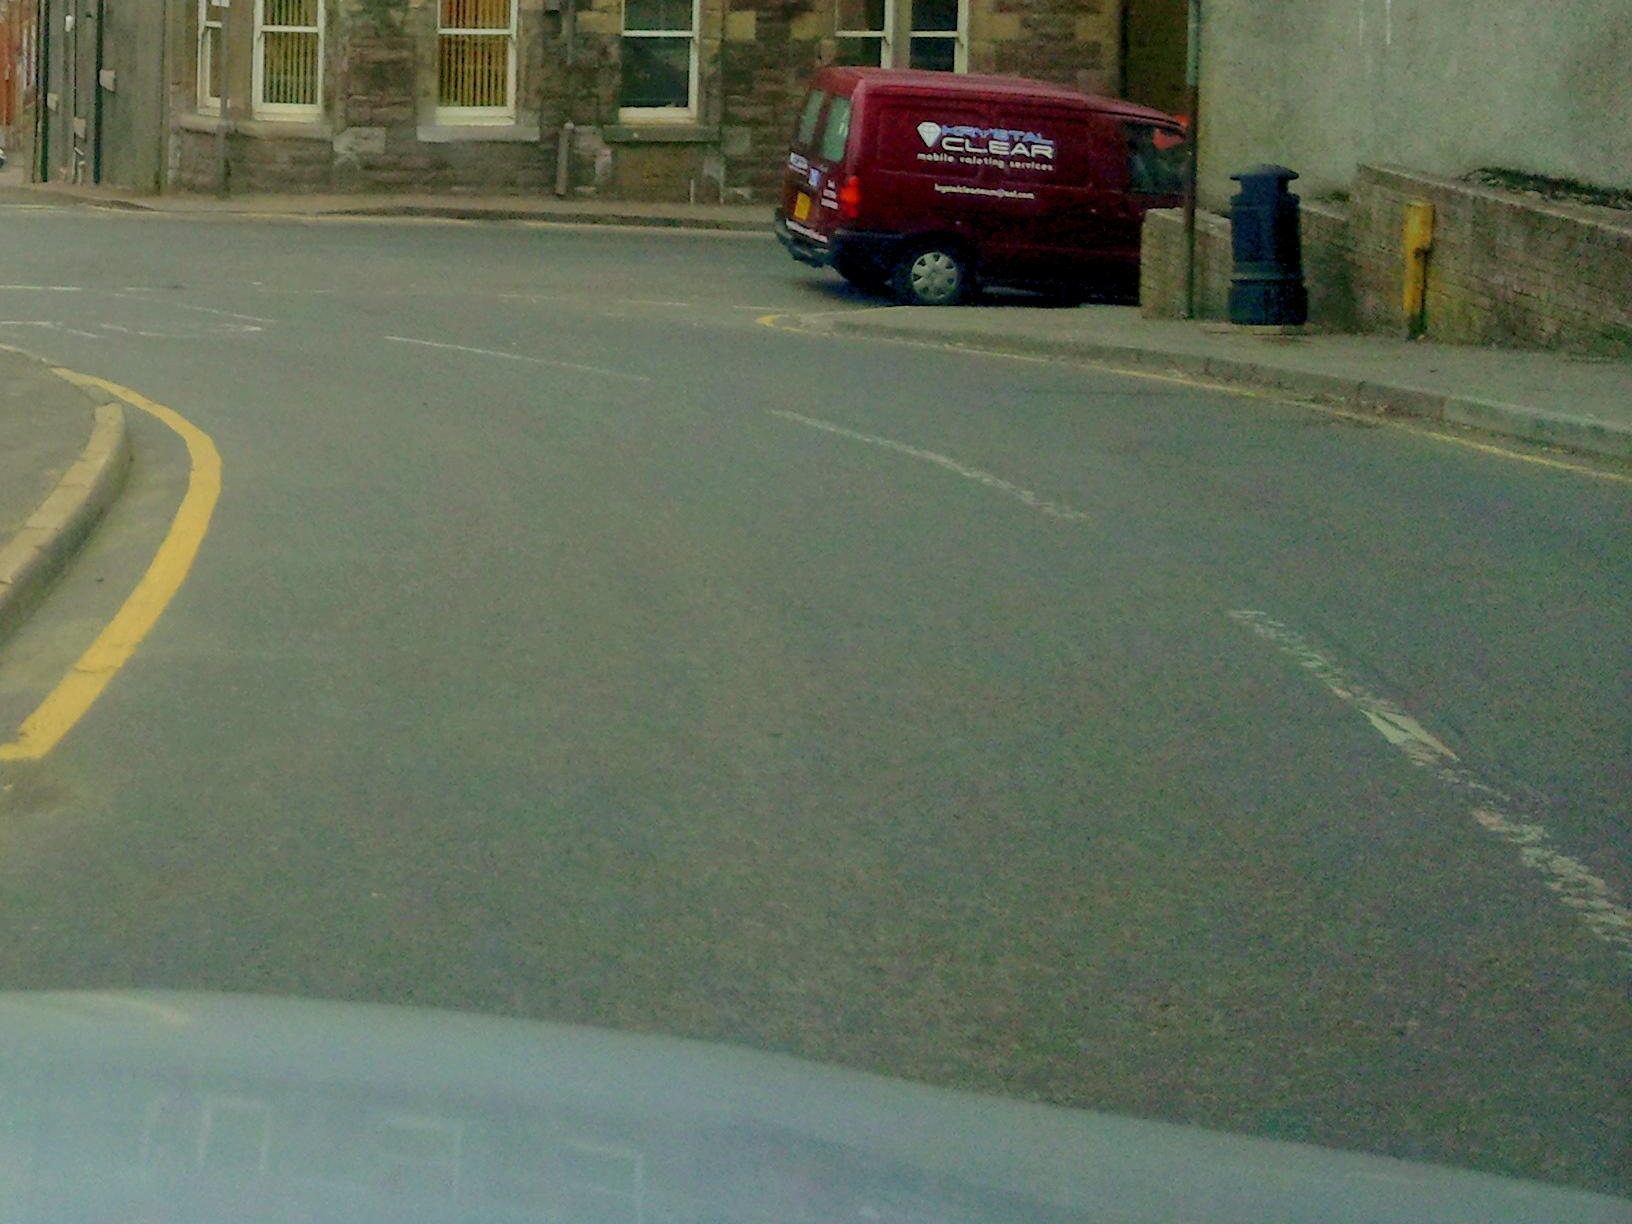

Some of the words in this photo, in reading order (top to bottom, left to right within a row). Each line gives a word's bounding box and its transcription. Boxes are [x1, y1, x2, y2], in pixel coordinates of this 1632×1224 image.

[941, 136, 1054, 159] CLEAR
[917, 153, 954, 163] mobile
[959, 156, 1005, 169] valeting
[1009, 160, 1053, 171] services
